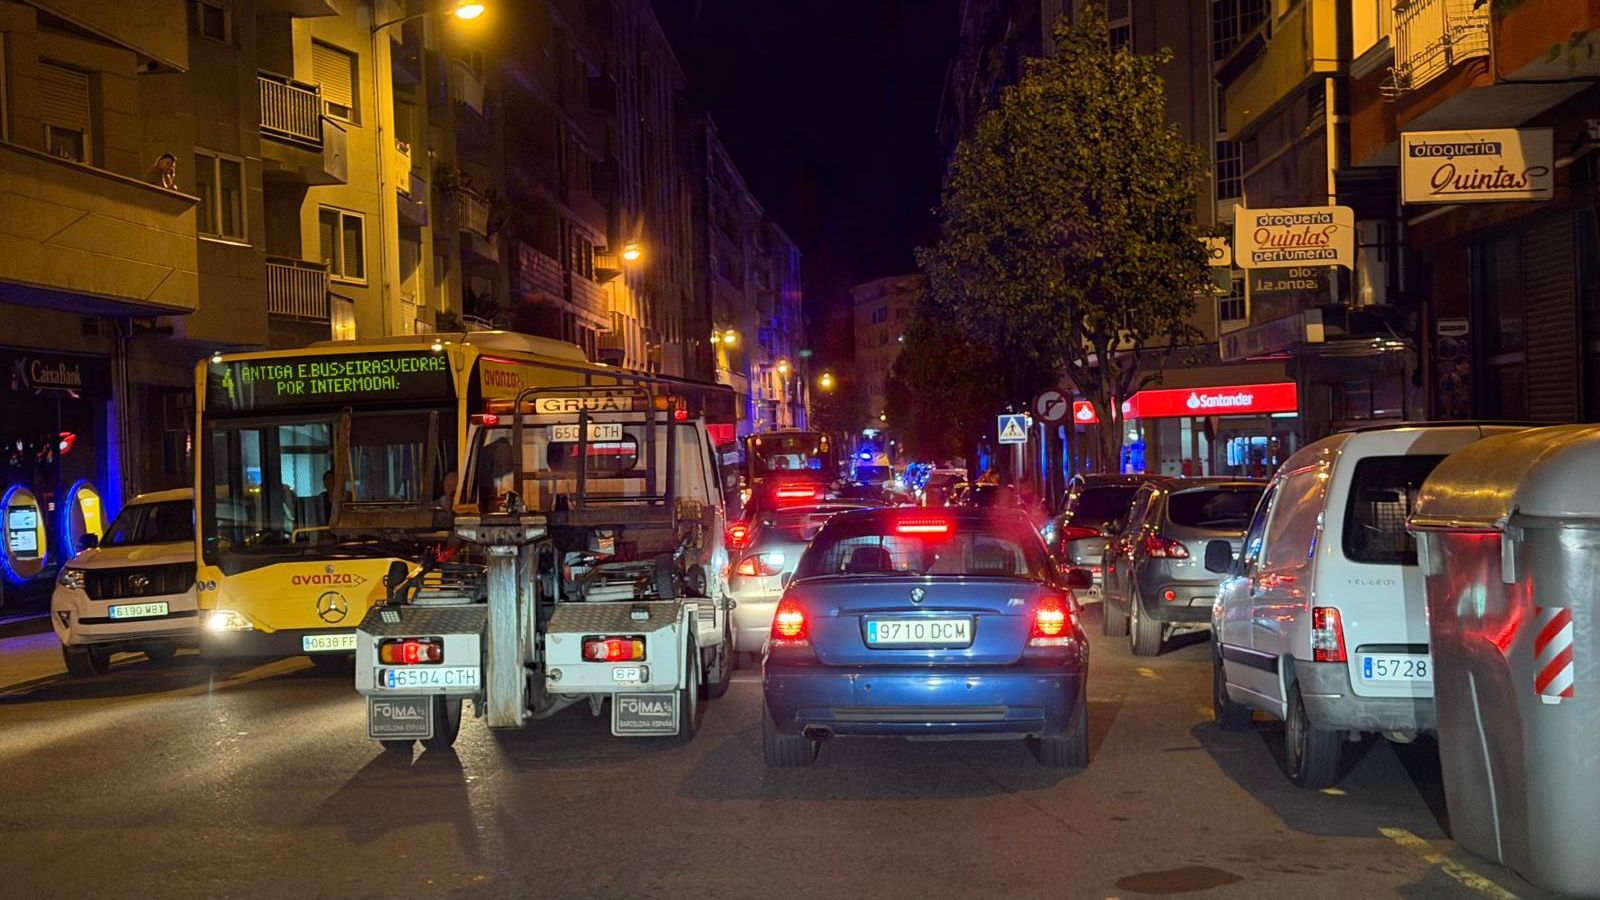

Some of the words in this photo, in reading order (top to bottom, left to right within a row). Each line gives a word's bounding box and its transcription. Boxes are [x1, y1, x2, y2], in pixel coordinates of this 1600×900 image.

[1415, 140, 1497, 160] drogueria
[1430, 163, 1549, 195] Quintas
[1258, 213, 1332, 227] drogueria
[1253, 225, 1338, 249] Quintas
[1253, 249, 1336, 264] perfumeria
[31, 360, 81, 385] CaixaBank
[241, 364, 293, 380] ANTIGA
[277, 380, 305, 395] POR
[543, 398, 619, 412] GRUA
[1200, 392, 1253, 407] Santander
[593, 425, 619, 438] CTH
[292, 573, 352, 586] avanza
[880, 624, 925, 639] 9710
[931, 623, 965, 639] DCM
[311, 637, 339, 648] 0638
[1377, 659, 1427, 677] 5728
[398, 670, 438, 685] 6504
[445, 669, 475, 685] CTH
